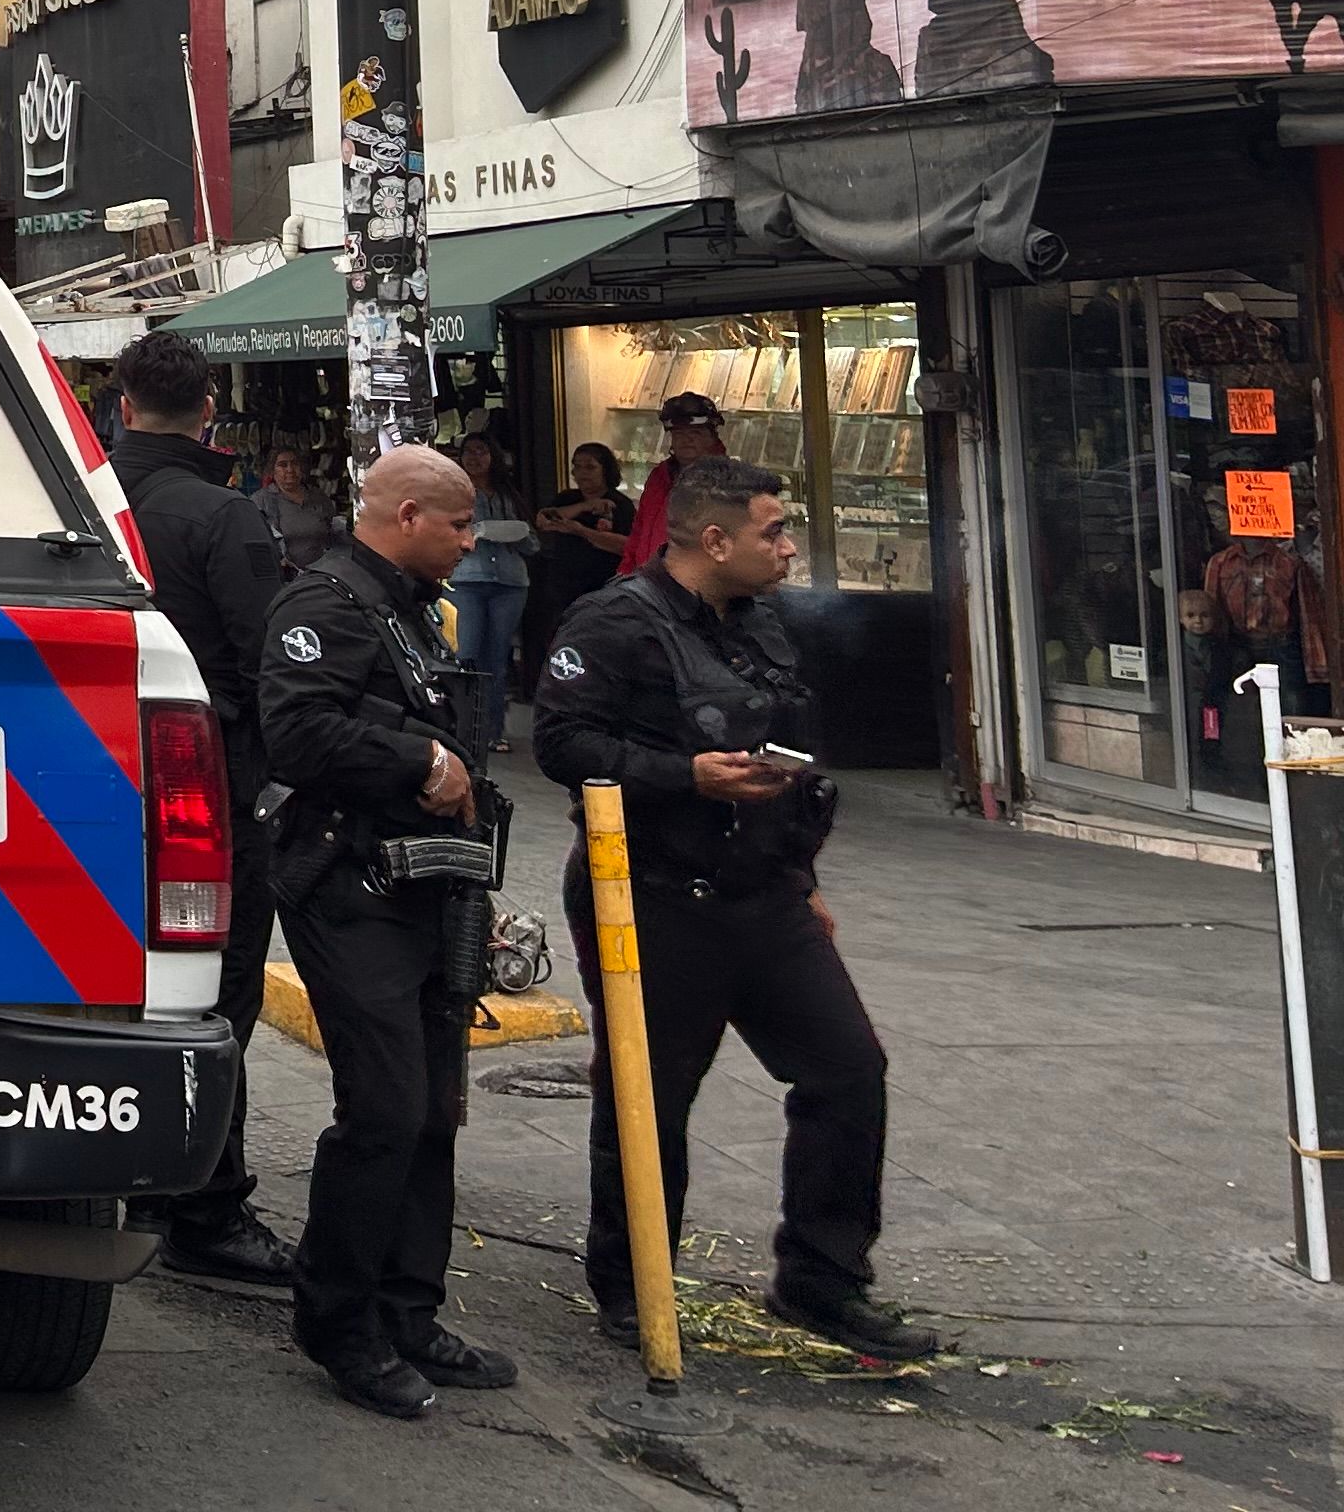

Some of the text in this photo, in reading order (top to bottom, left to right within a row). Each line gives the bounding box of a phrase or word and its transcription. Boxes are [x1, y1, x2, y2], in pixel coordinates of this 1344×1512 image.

[475, 154, 556, 198] FINAS
[545, 286, 650, 302] JOYAS FINAS
